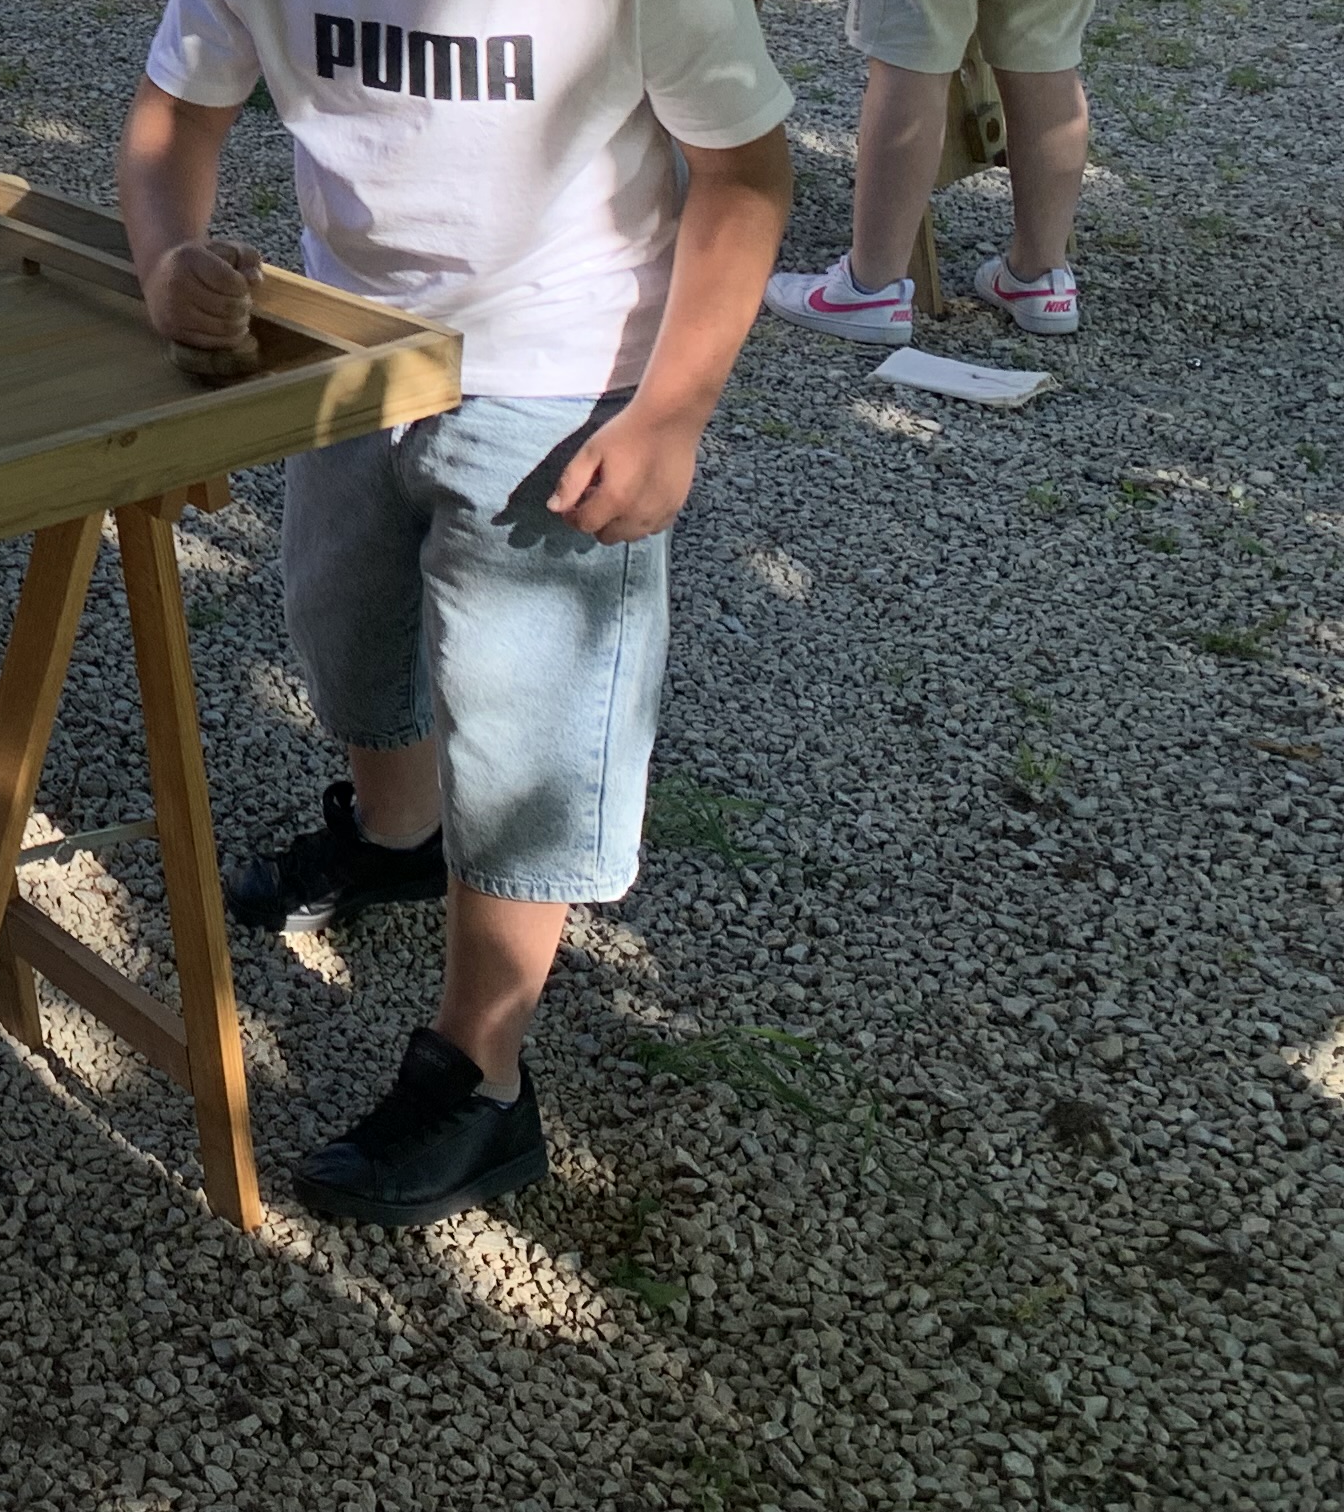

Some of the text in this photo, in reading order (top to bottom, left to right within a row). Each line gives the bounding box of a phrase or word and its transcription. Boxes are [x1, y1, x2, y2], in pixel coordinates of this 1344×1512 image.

[314, 13, 535, 101] PUMA
[1043, 299, 1071, 313] NIKE
[889, 310, 912, 323] NIK
